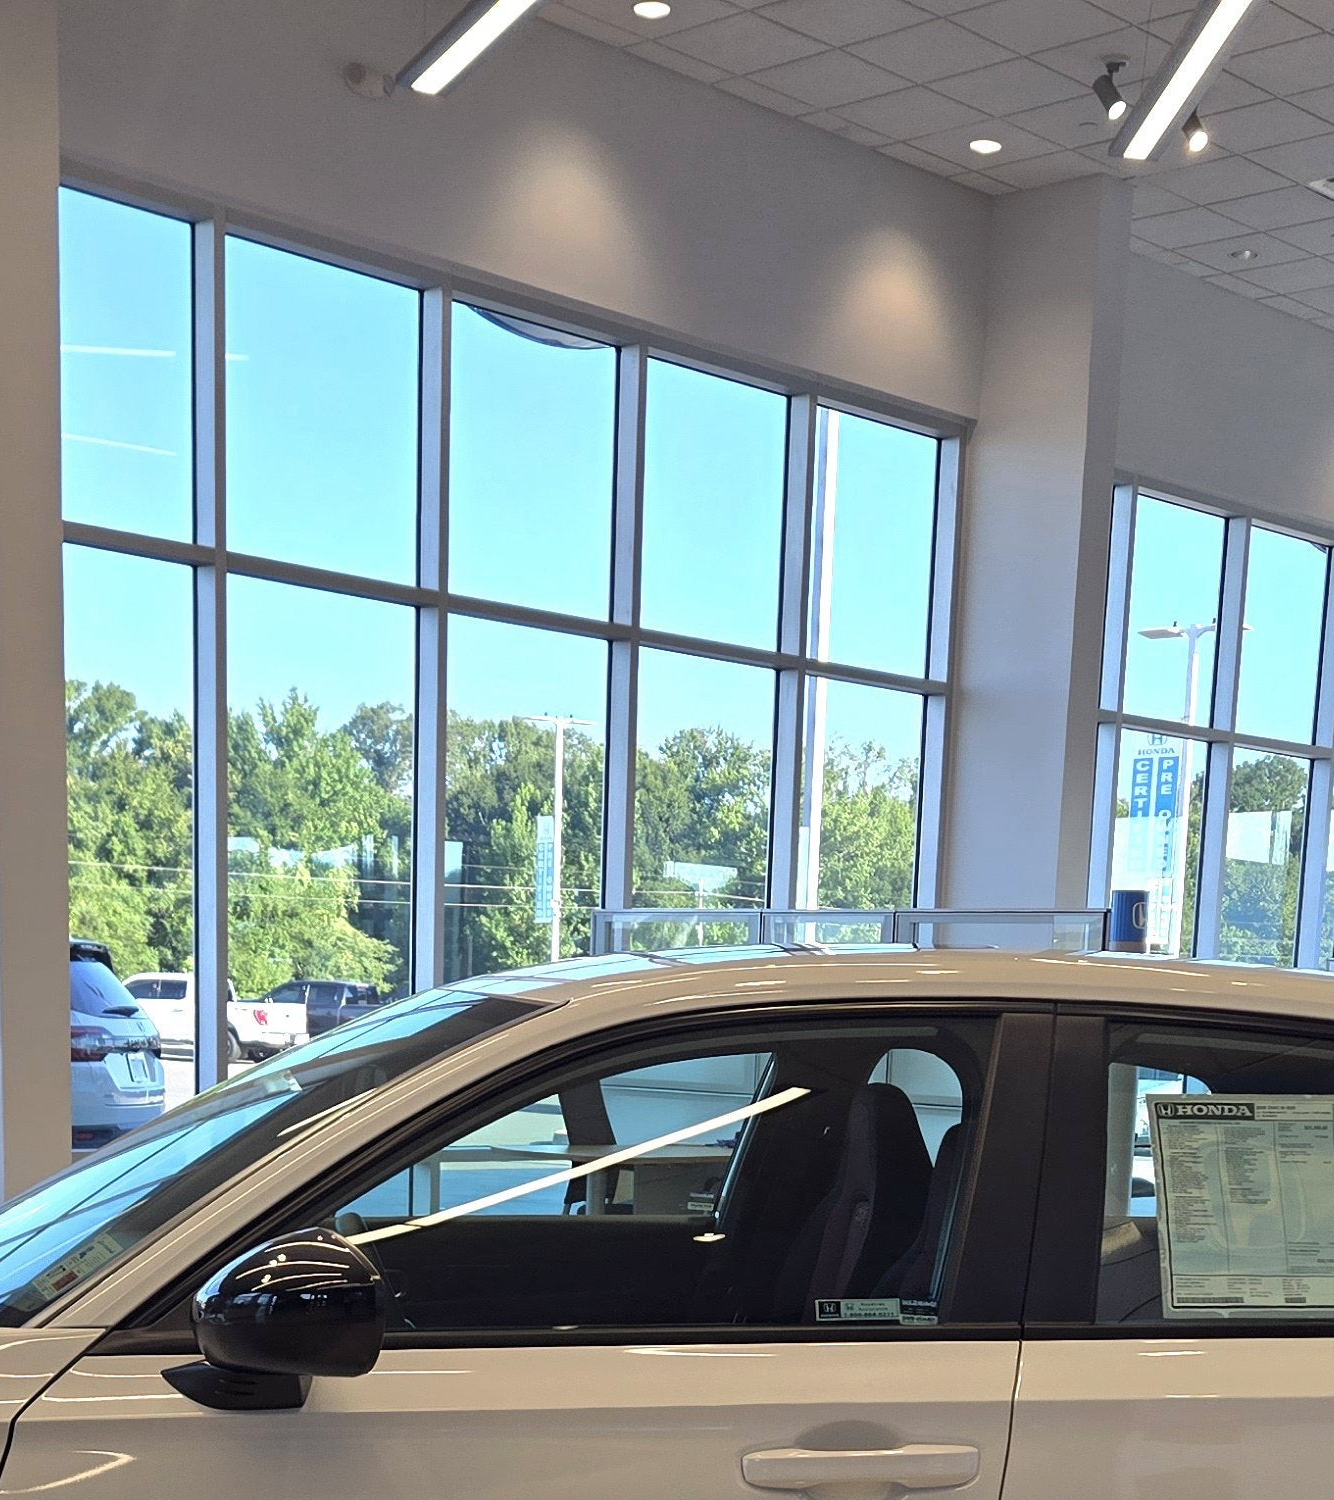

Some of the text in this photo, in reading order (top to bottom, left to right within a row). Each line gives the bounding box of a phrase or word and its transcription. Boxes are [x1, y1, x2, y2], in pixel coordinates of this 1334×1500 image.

[1137, 747, 1176, 756] HONDA
[1160, 759, 1175, 796] PRE
[1176, 1105, 1253, 1117] HONDA
